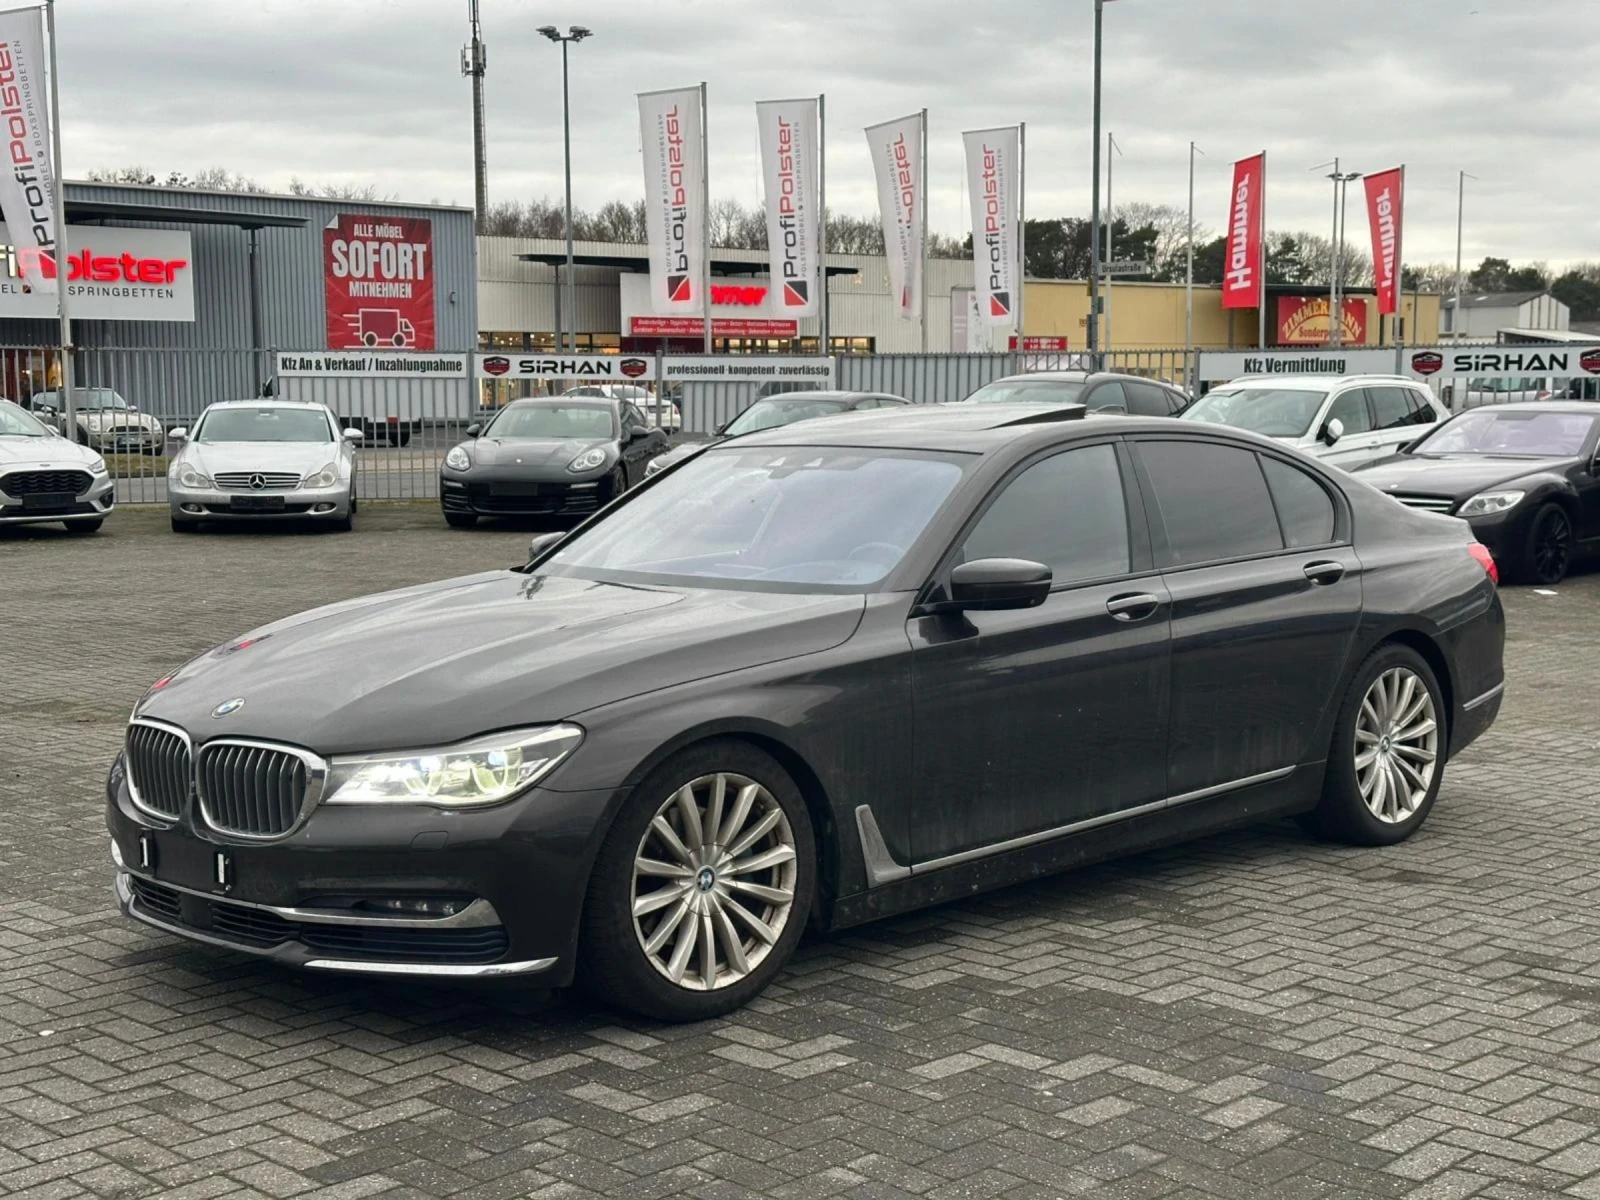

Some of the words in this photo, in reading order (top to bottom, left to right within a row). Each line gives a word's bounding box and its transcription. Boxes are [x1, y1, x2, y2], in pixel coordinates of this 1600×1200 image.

[13, 40, 42, 147] BOXSPRINGBETTEN
[778, 115, 798, 278] ProfiPolster
[982, 143, 1002, 290] ProfiPolster
[353, 224, 374, 238] ALLE
[375, 223, 404, 238] MÖBEL
[331, 239, 427, 280] SOFORT
[68, 285, 174, 299] SPRINGBETTEN
[349, 281, 412, 298] MITNEHMEN
[281, 357, 297, 371] Kfz
[300, 358, 312, 371] An
[315, 358, 322, 371] &
[324, 358, 366, 371] Verkauf
[375, 358, 462, 373] Inzahlungnahme
[1244, 358, 1262, 373] Kfz
[1265, 357, 1346, 374] Vermittlung
